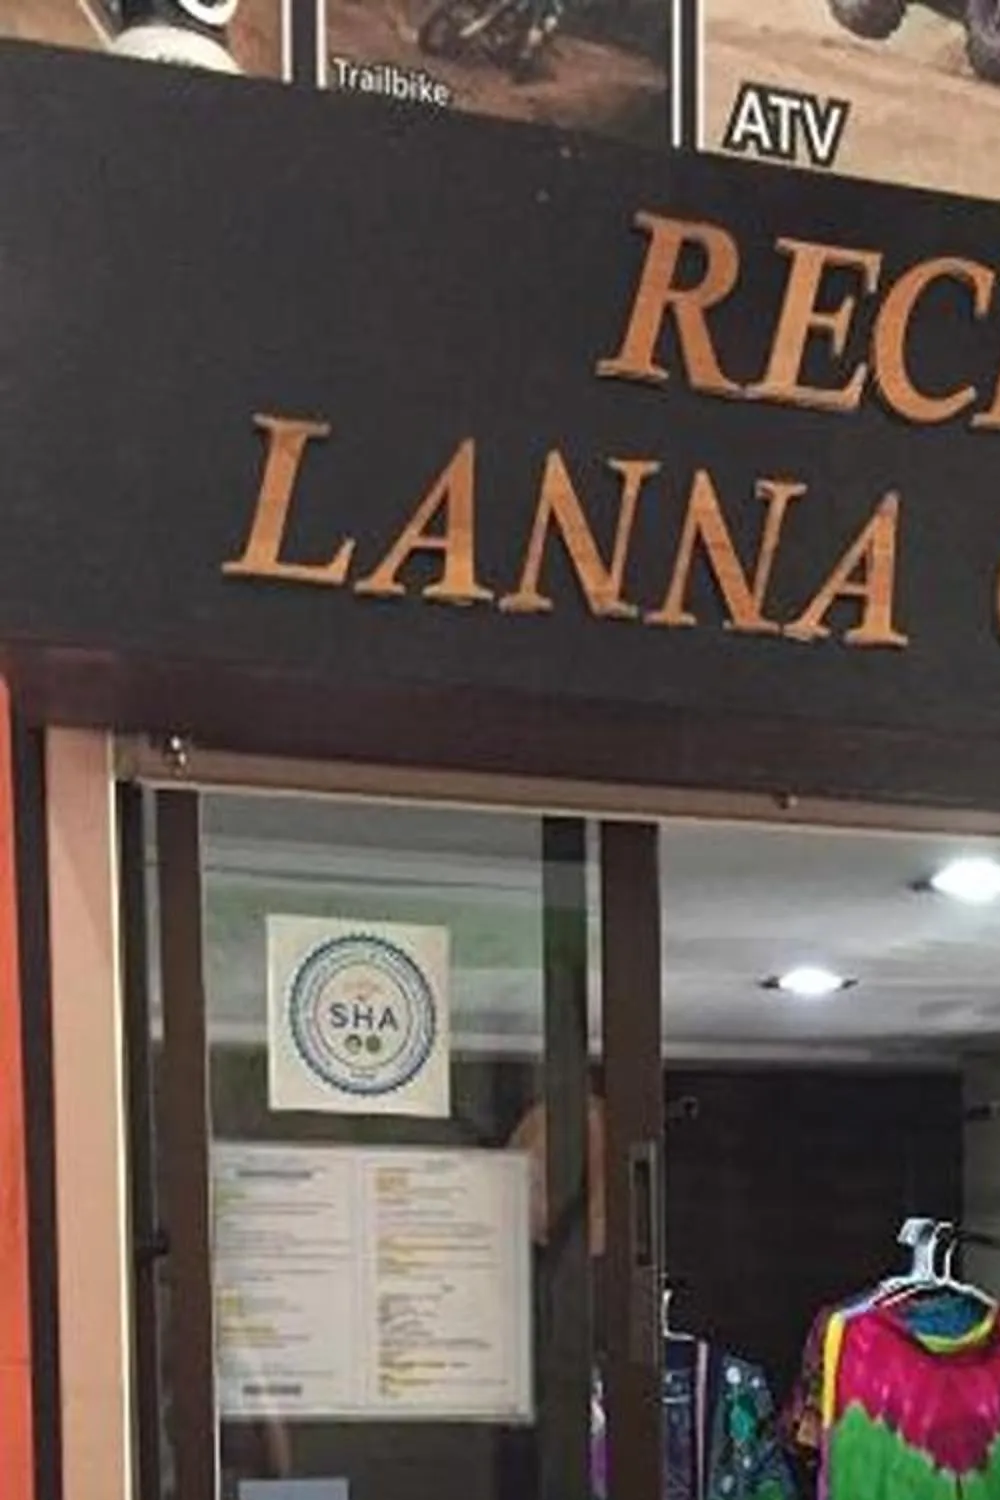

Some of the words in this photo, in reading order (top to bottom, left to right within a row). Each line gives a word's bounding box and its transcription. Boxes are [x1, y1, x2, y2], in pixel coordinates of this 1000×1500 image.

[332, 58, 450, 107] Trailbike
[725, 84, 849, 165] ATV
[221, 411, 909, 649] LANNA
[330, 1002, 398, 1031] SHA
